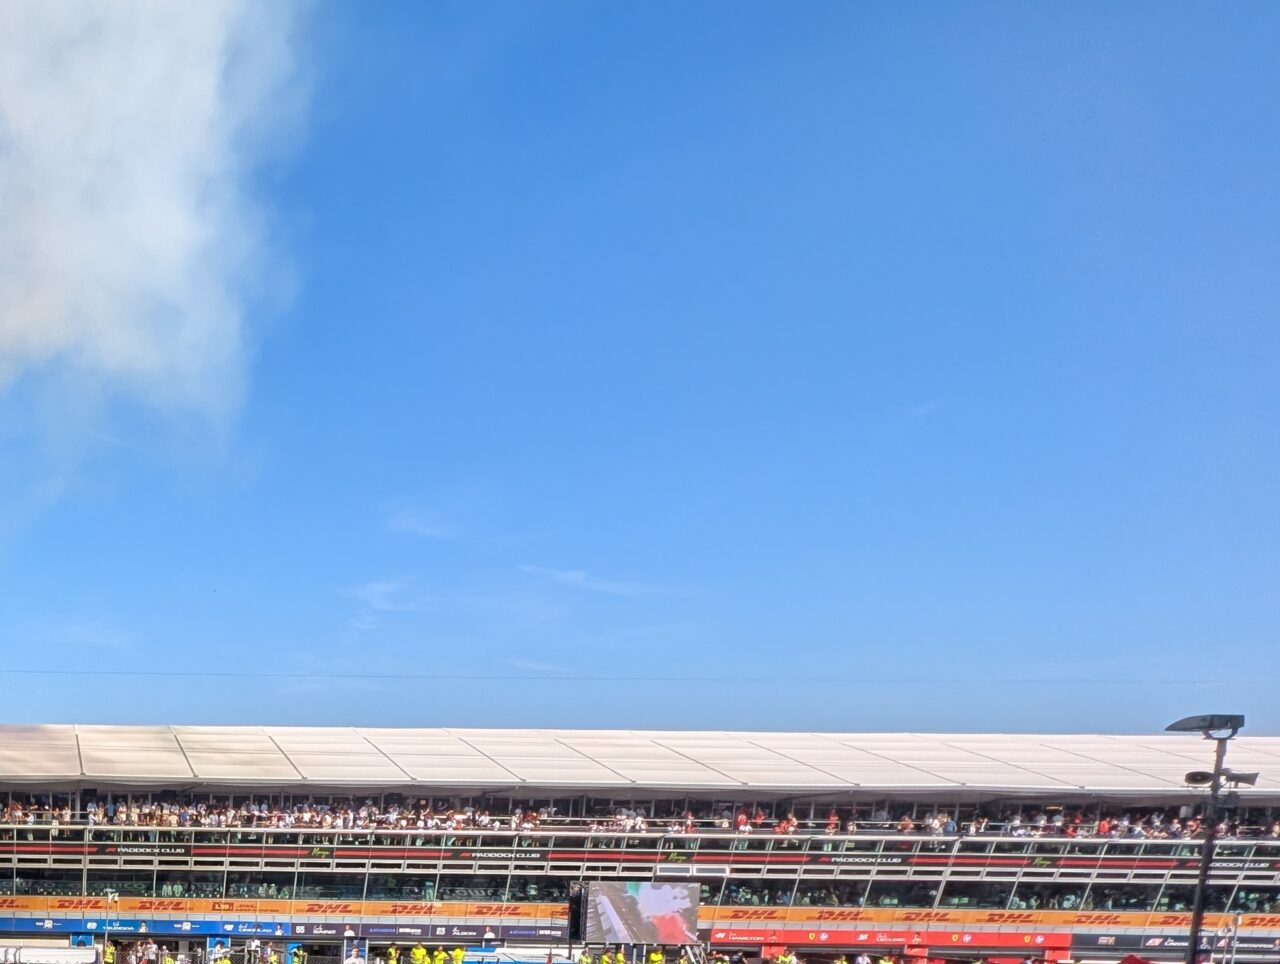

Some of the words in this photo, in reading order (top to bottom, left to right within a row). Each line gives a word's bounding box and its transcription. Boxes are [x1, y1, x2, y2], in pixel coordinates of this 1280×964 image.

[56, 900, 106, 909] DHL
[137, 901, 186, 911] DHL
[305, 904, 354, 914] DHL
[390, 904, 438, 914] DHL
[473, 905, 524, 915] DHL
[728, 909, 780, 920] DHL
[816, 911, 865, 921] DHL
[902, 912, 953, 922] DHL
[985, 912, 1035, 923] DHL
[1072, 914, 1121, 925] DHL
[1245, 916, 1280, 926] DH
